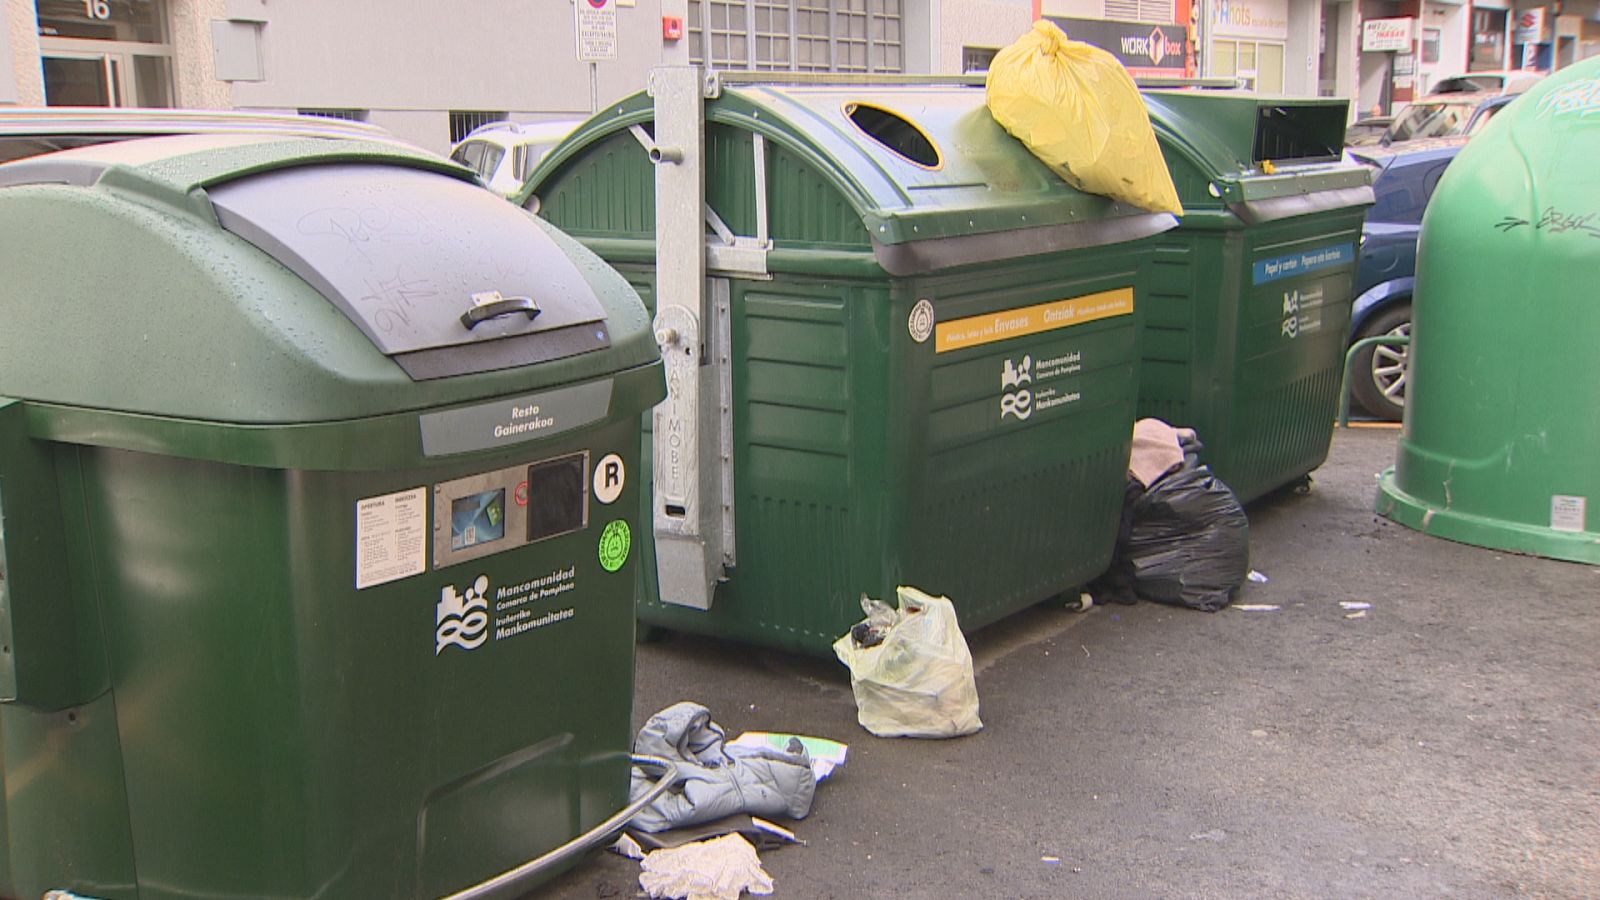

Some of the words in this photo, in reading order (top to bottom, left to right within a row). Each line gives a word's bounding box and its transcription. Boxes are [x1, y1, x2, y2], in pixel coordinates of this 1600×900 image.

[85, 0, 111, 19] 16
[1121, 36, 1149, 56] WORK
[1165, 35, 1181, 56] box
[1043, 304, 1075, 323] Ontziak
[994, 315, 1029, 334] Envases
[1036, 350, 1081, 370] Mancomunidad
[1036, 392, 1080, 411] Mankomunitatea
[512, 404, 540, 420] Resto
[494, 416, 554, 438] Gainerakoa
[605, 461, 619, 488] R
[497, 565, 575, 600] Mancomunidad
[496, 595, 528, 611] Comarca
[529, 591, 539, 601] de
[540, 582, 575, 598] Pamplona
[496, 608, 575, 640] Mankomunitatea
